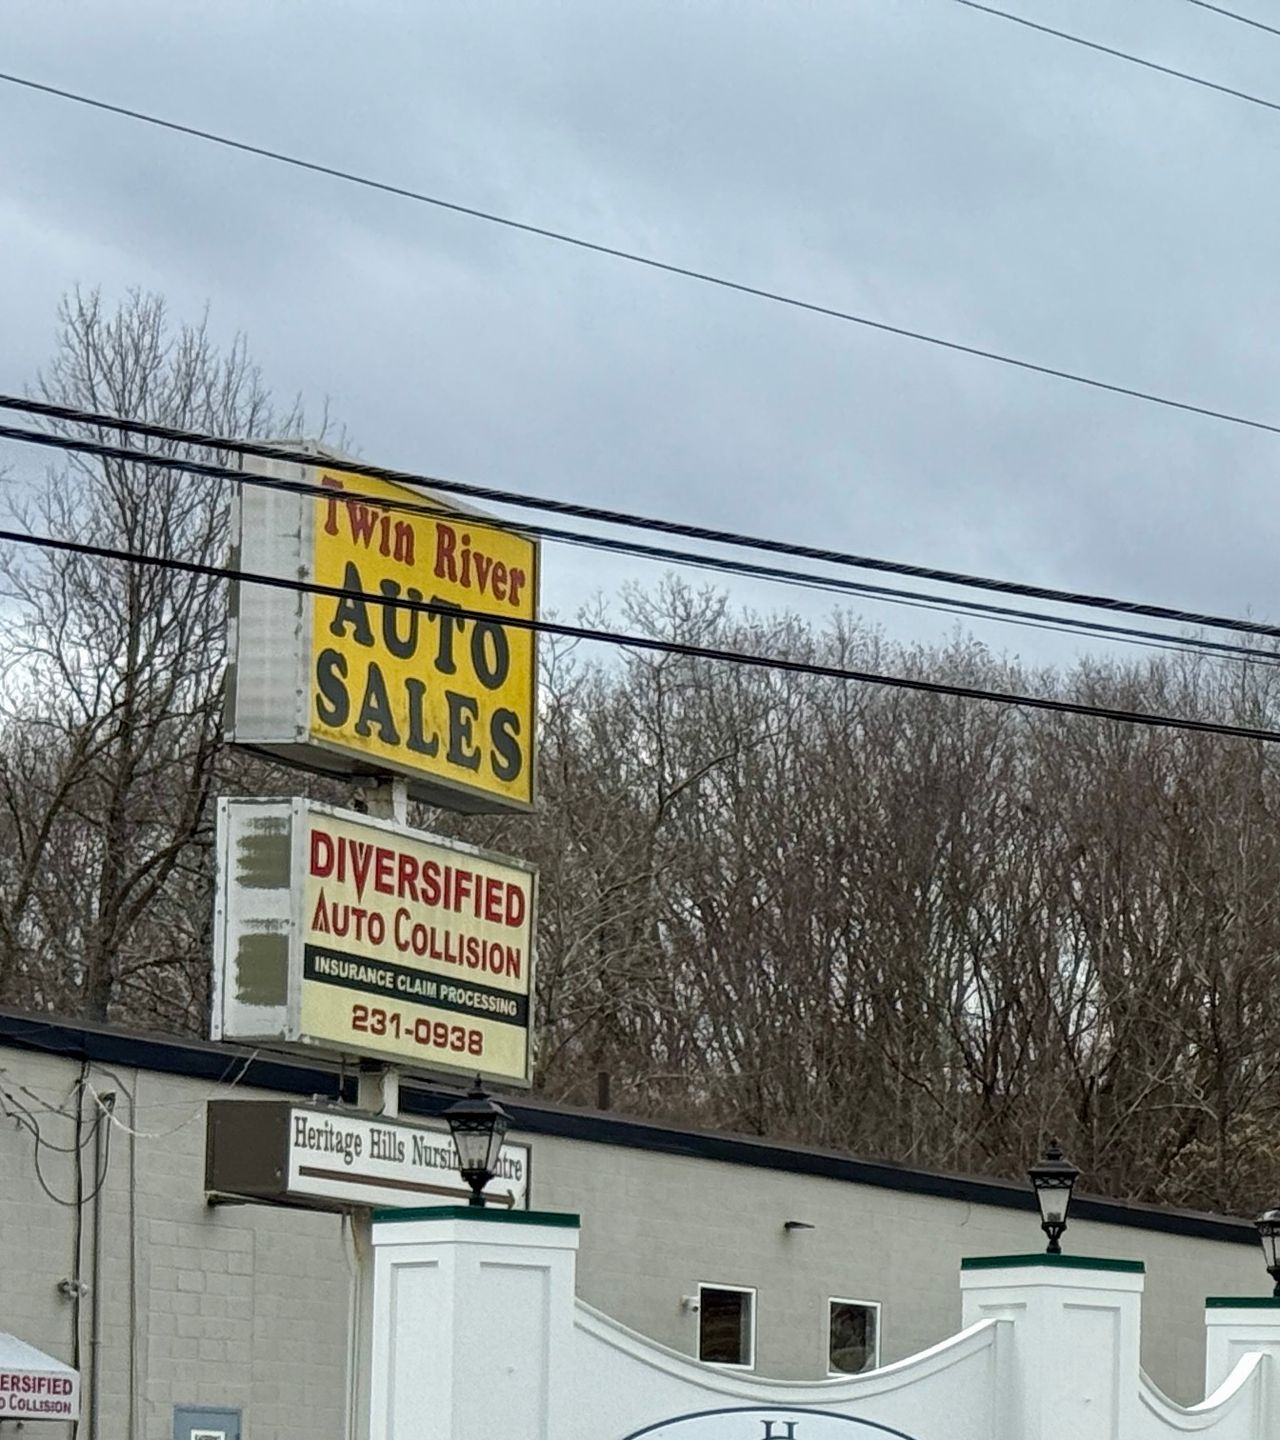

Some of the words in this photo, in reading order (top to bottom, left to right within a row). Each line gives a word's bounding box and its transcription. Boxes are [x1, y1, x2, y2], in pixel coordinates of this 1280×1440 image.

[321, 475, 416, 567] Twin
[434, 521, 526, 607] River
[330, 560, 510, 690] AUTO
[315, 647, 523, 782] SALES
[310, 829, 526, 929] DIVERSIFIED
[314, 955, 394, 989] INSURANCE
[397, 974, 438, 999] CLAIM
[440, 984, 518, 1017] PROCESSING
[352, 1003, 484, 1056] 231-0938
[294, 1116, 363, 1166] Heritage
[369, 1128, 406, 1163] Hills
[412, 1134, 465, 1172] Nursin
